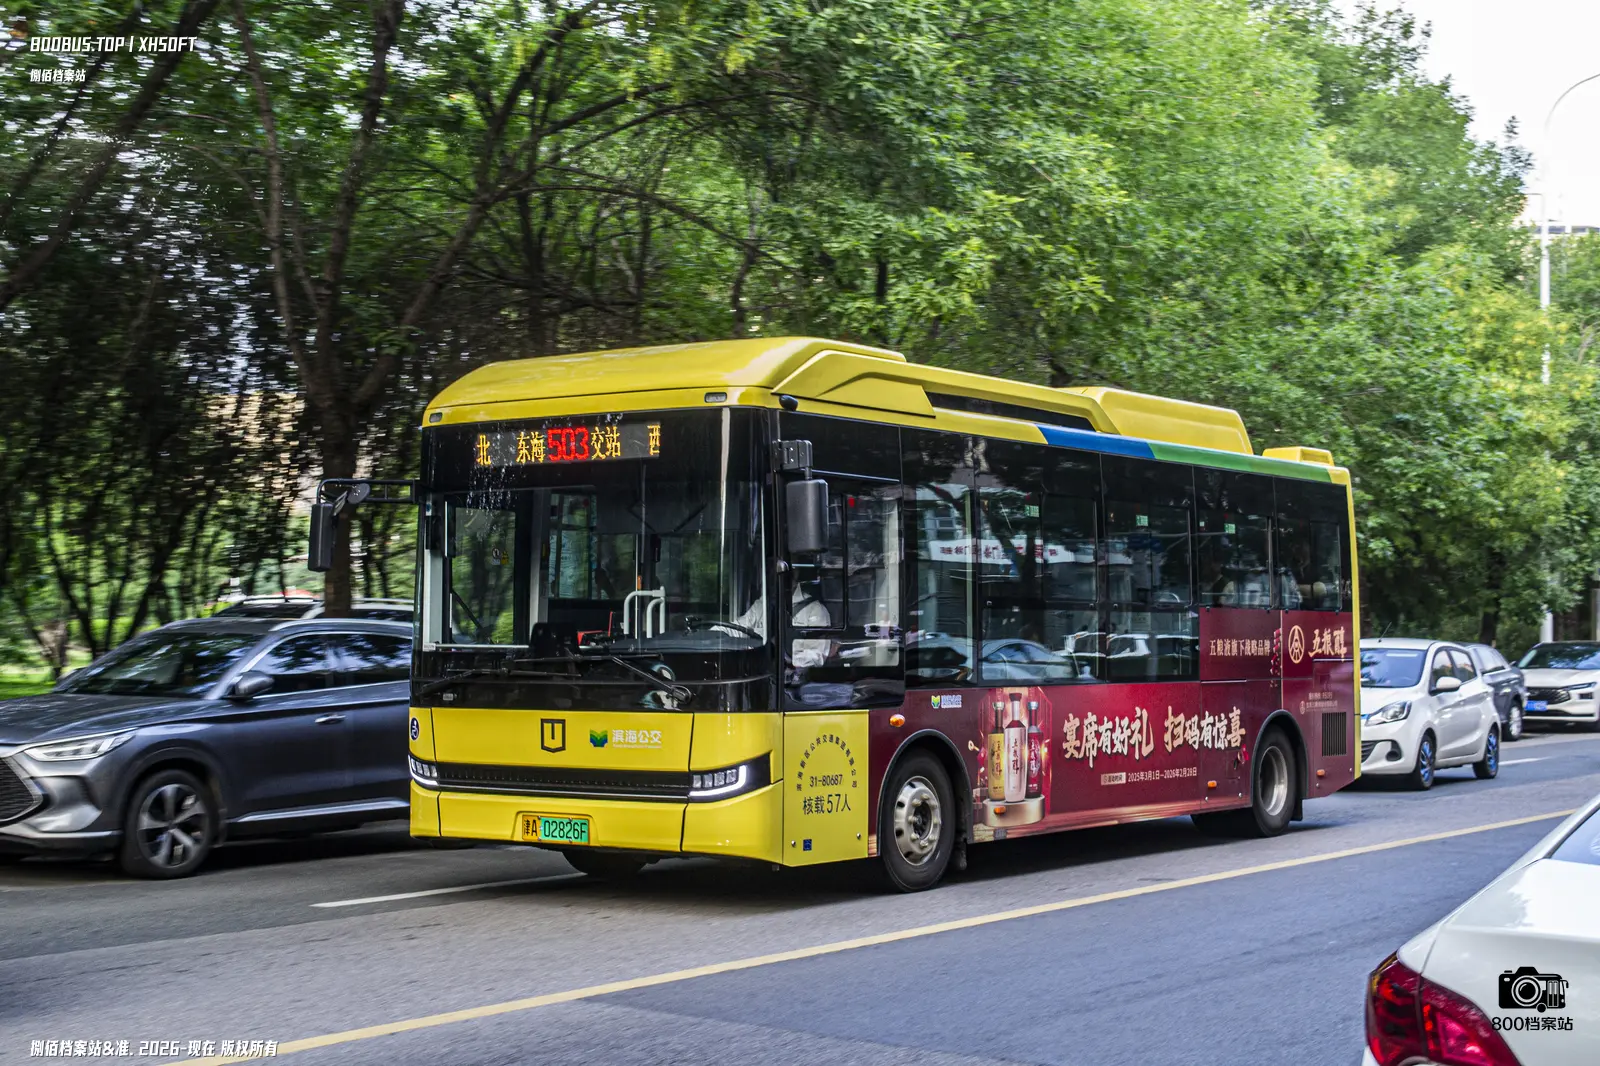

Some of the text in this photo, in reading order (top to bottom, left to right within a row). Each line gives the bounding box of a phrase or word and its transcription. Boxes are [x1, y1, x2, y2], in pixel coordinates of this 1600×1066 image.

[476, 434, 491, 466] 北
[516, 431, 546, 464] 东海
[547, 427, 590, 462] 503
[590, 426, 621, 461] 交站
[611, 729, 662, 745] 滨海公交
[1062, 705, 1246, 769] 宴席有好礼 扫码有惊喜
[809, 774, 843, 788] 31-80687
[802, 793, 852, 816] 核载57人
